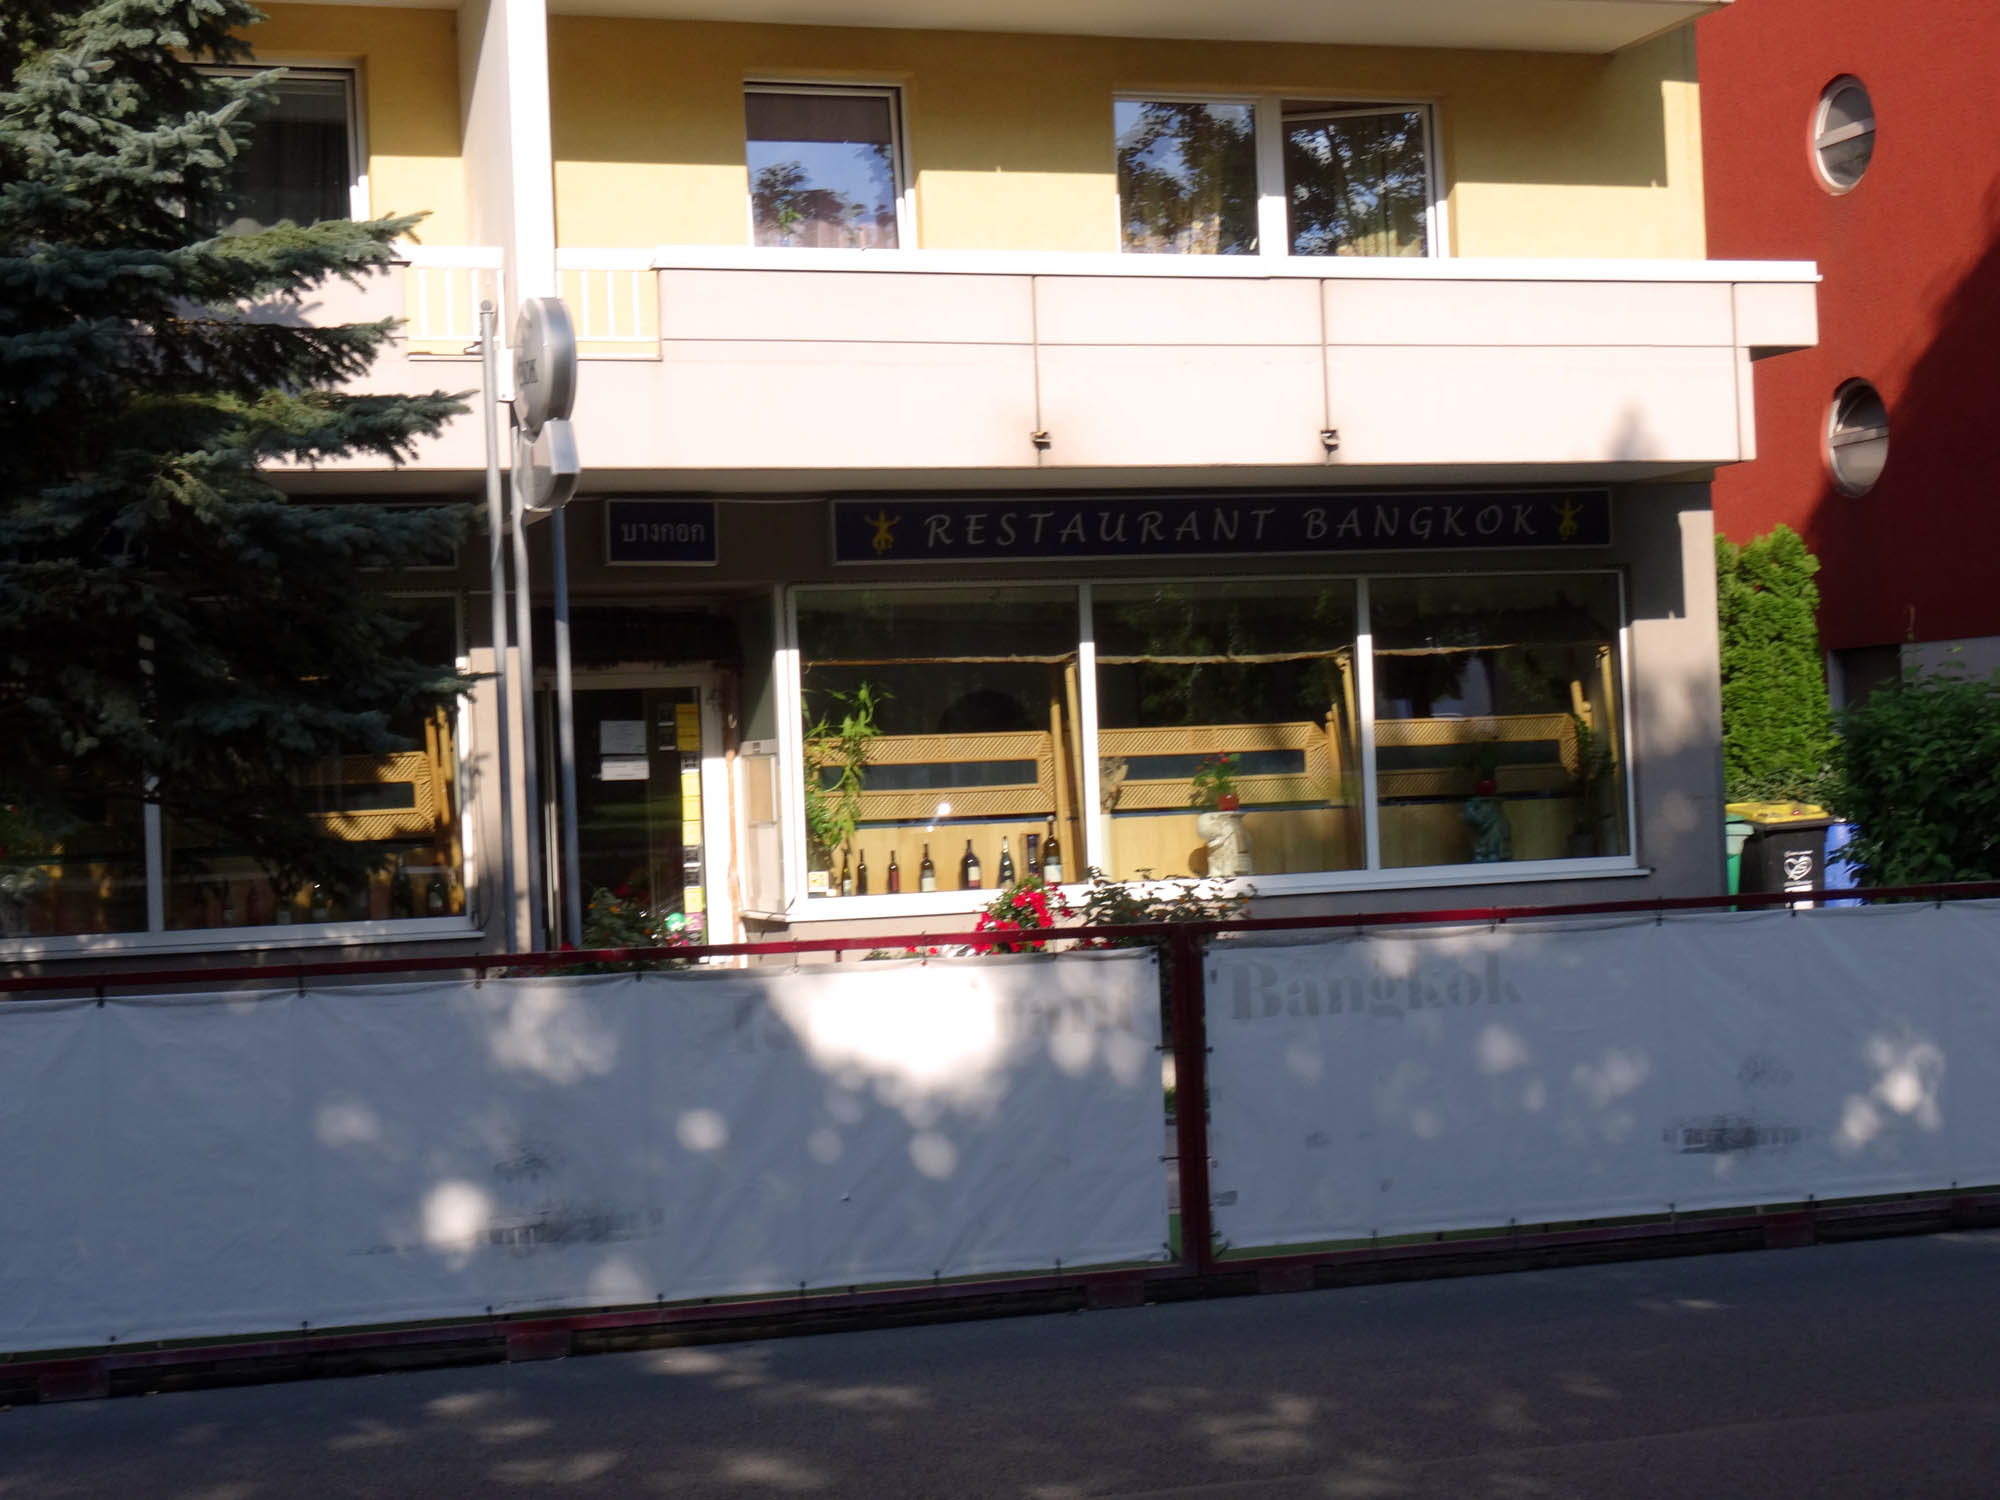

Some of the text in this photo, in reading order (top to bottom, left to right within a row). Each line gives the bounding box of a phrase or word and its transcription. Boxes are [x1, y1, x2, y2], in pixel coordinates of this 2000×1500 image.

[621, 523, 705, 542] บางกอก
[924, 504, 1537, 548] RESTAURANT BANGKOK
[1231, 953, 1521, 1019] Bangkok
